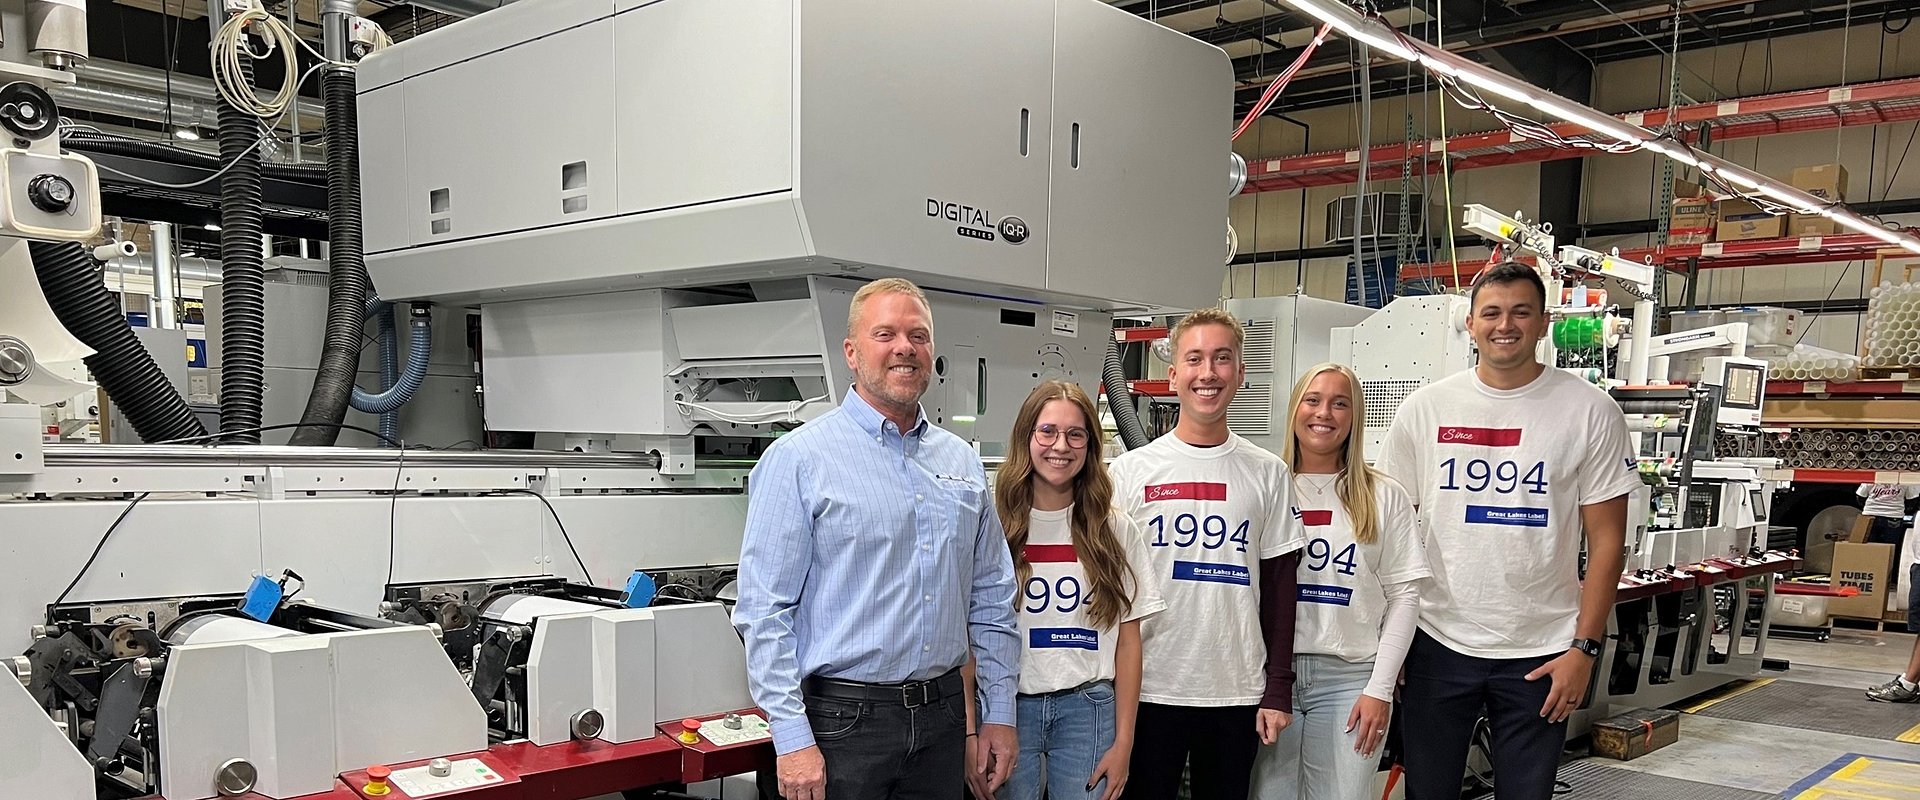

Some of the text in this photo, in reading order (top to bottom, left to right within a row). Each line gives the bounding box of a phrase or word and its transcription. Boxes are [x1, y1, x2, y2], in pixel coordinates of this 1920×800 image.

[927, 198, 996, 229] DIGITAL
[959, 228, 993, 240] SERIES
[1442, 428, 1474, 440] Since
[1439, 457, 1549, 495] 1994
[1149, 486, 1180, 499] Since
[1486, 510, 1506, 518] Great
[1148, 513, 1250, 554] 1994
[1297, 537, 1358, 577] 94
[1193, 567, 1212, 575] Great
[1212, 568, 1231, 576] Lakes
[1840, 571, 1874, 581] TUBES
[1014, 576, 1100, 615] 99
